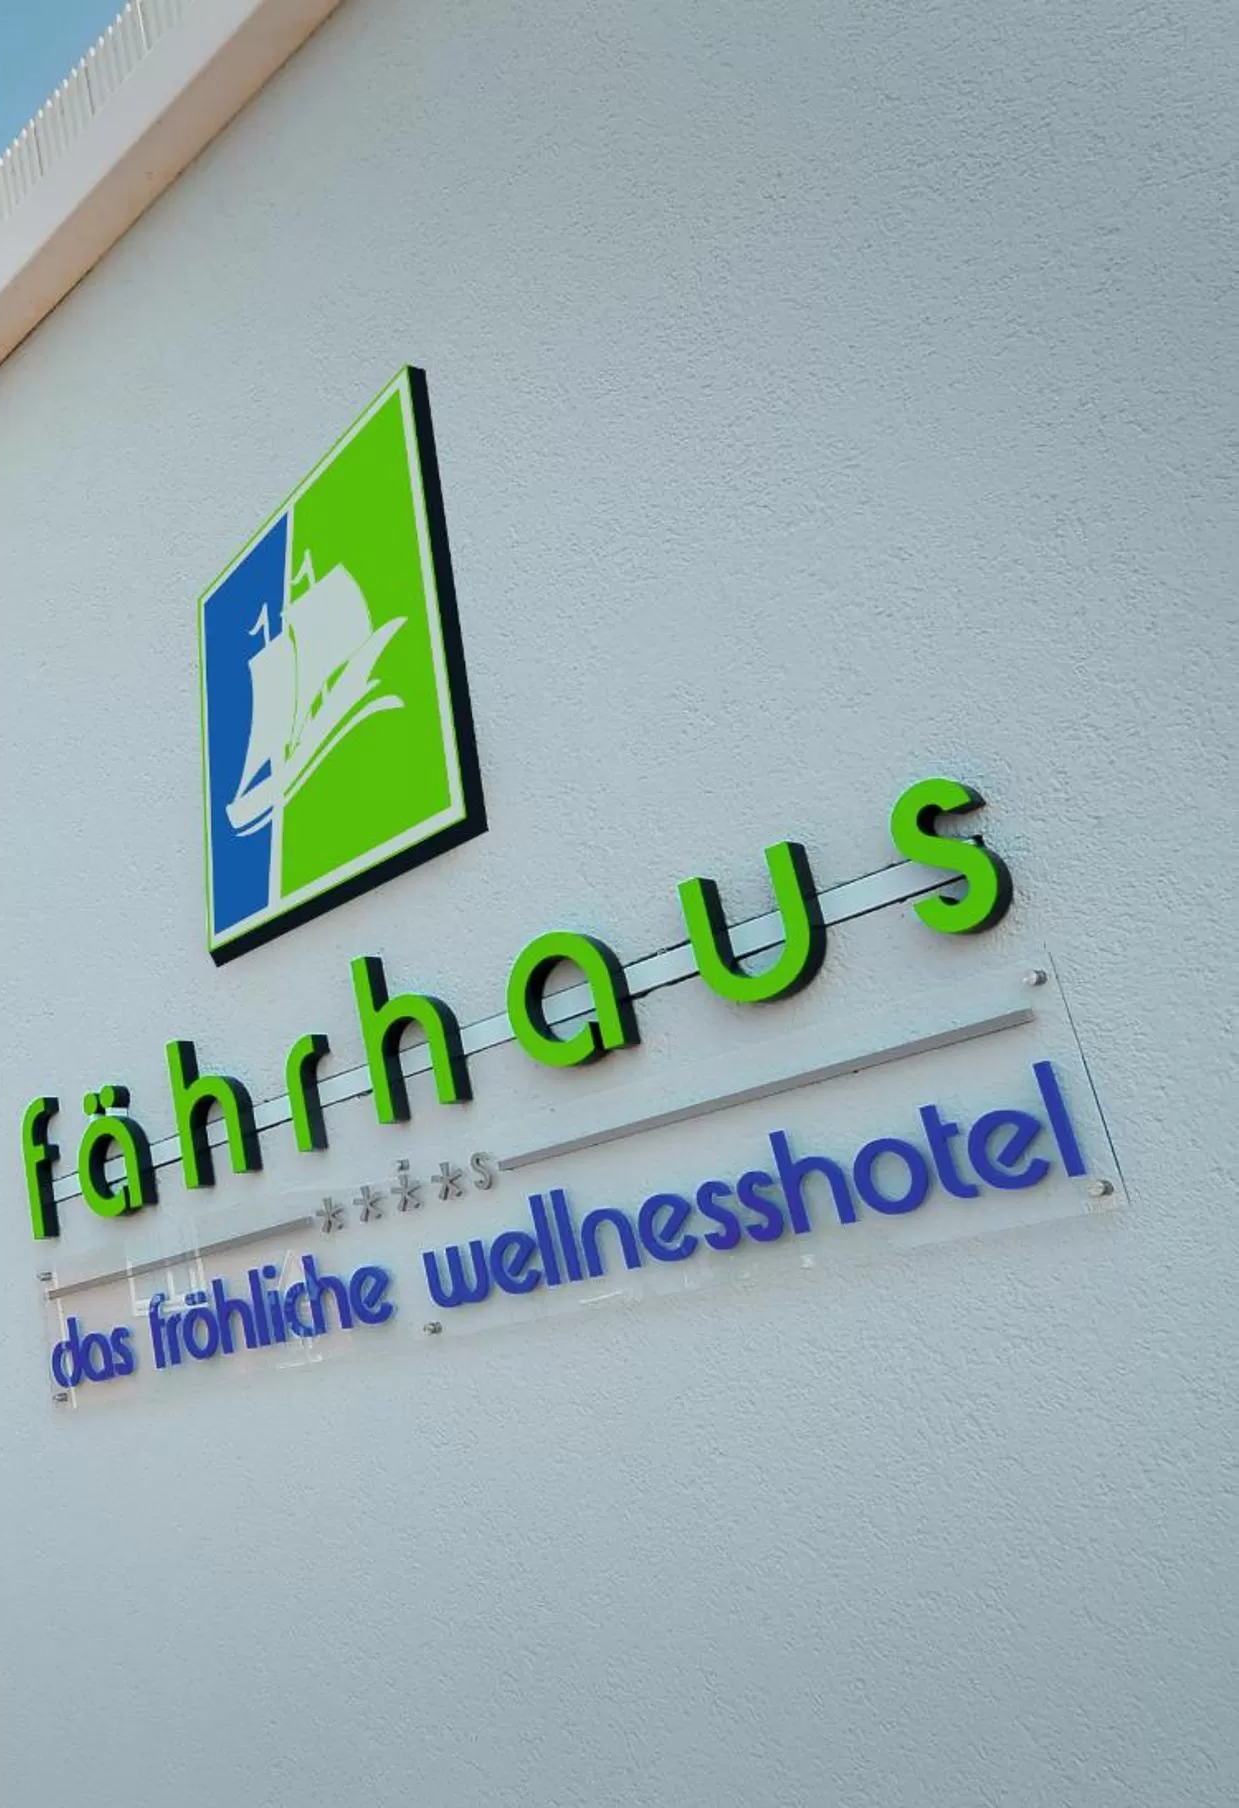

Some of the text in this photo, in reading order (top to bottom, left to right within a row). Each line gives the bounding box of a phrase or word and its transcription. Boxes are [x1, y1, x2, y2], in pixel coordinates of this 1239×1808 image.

[22, 777, 1014, 1241] fährhaus
[51, 1060, 1087, 1388] das fröhliche wellnesshotel
